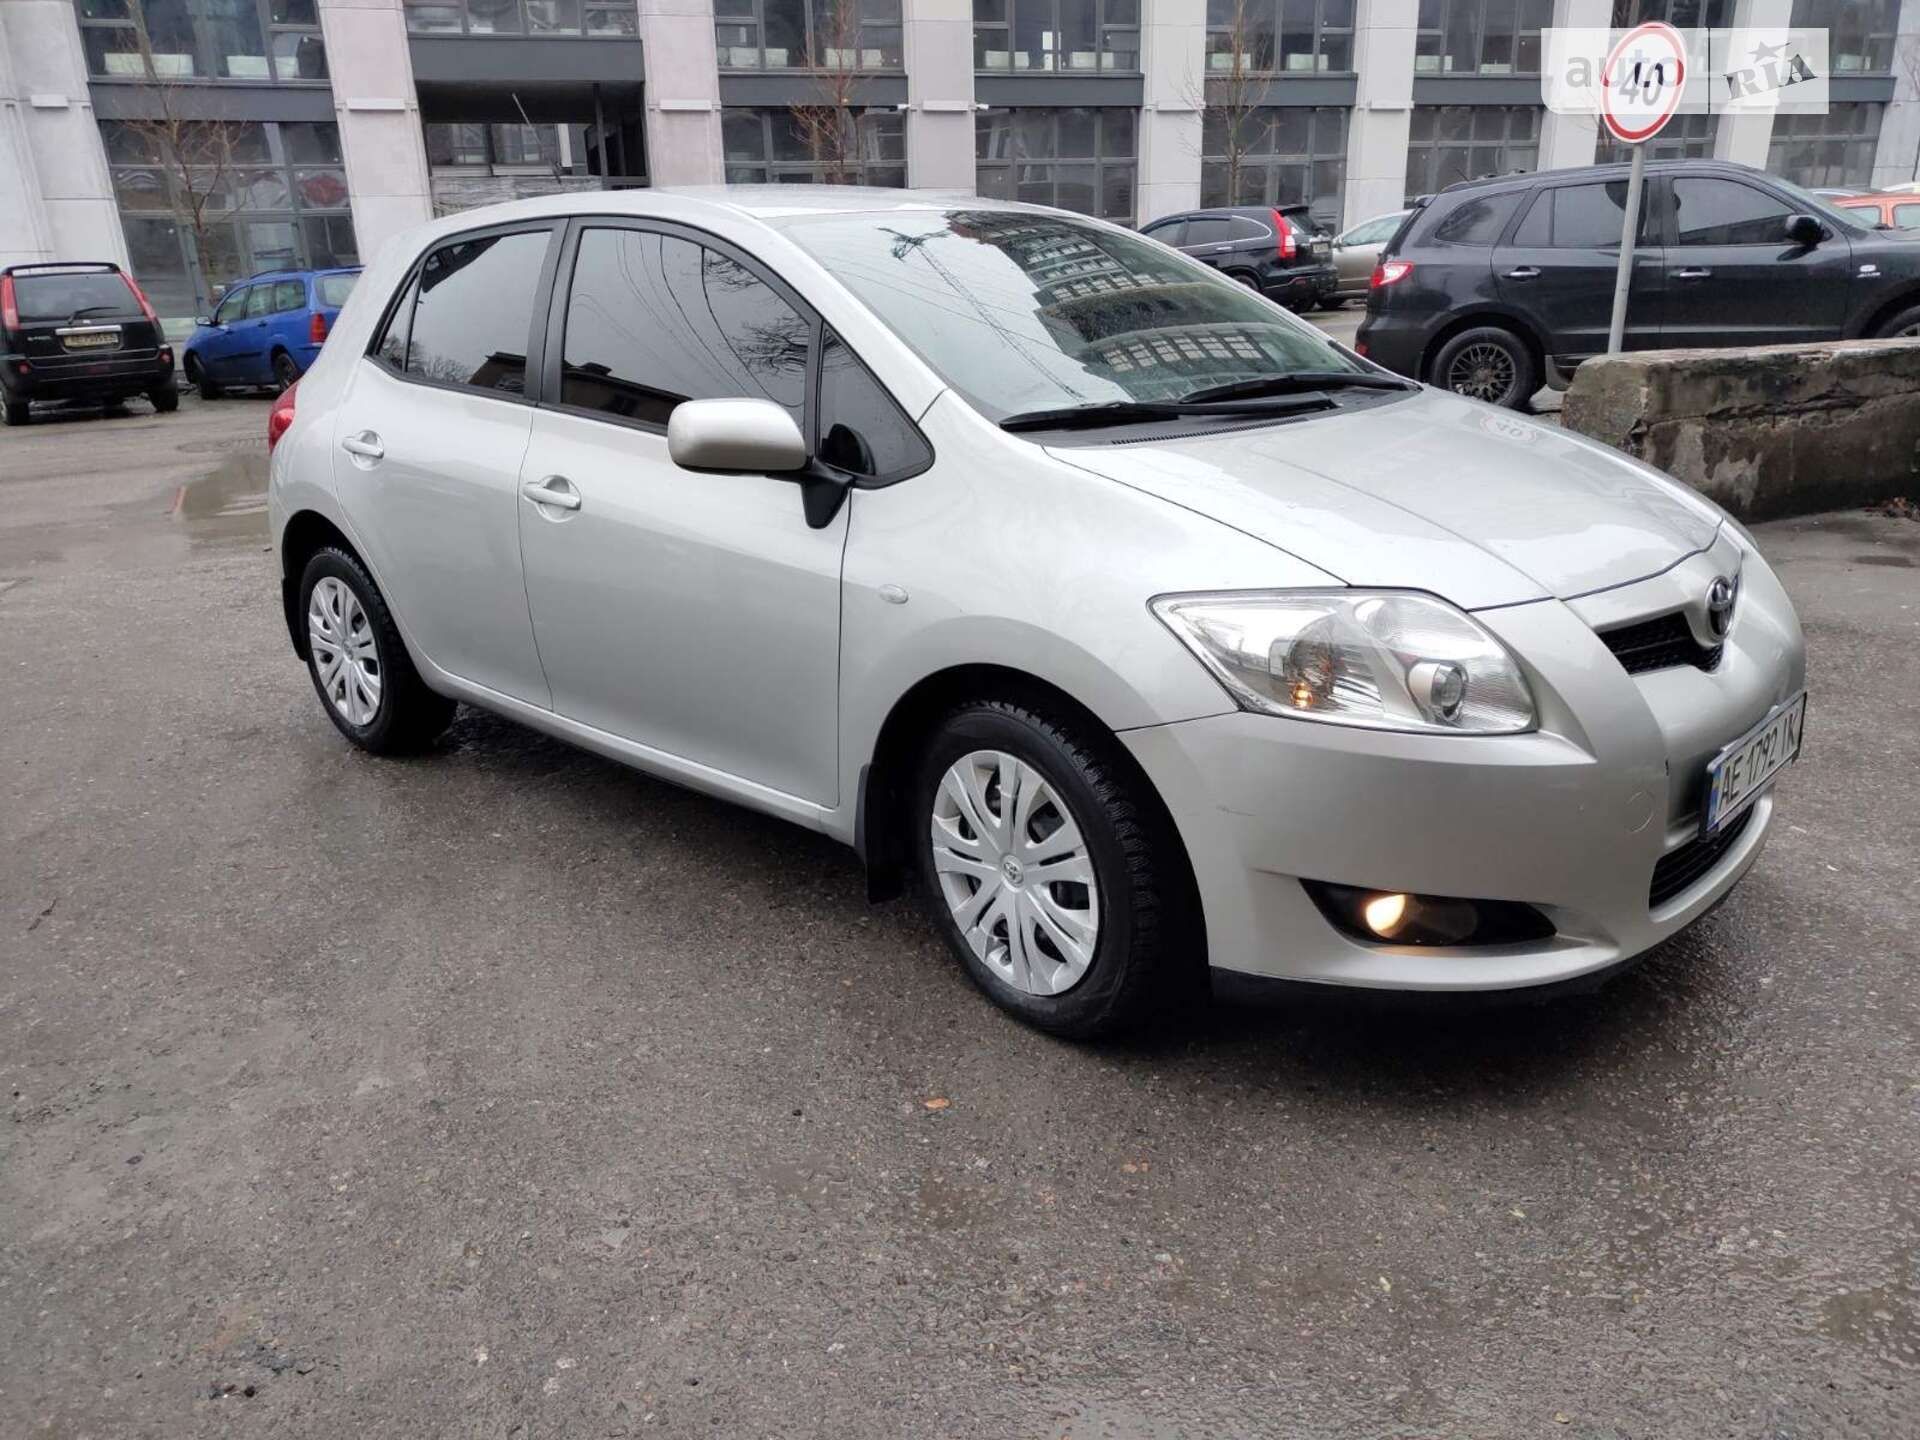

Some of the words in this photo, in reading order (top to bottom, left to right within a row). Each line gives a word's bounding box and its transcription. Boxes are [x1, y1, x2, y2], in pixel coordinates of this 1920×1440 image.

[1619, 62, 1664, 106] 40
[1720, 754, 1744, 809] AE
[1747, 726, 1778, 785] 1792
